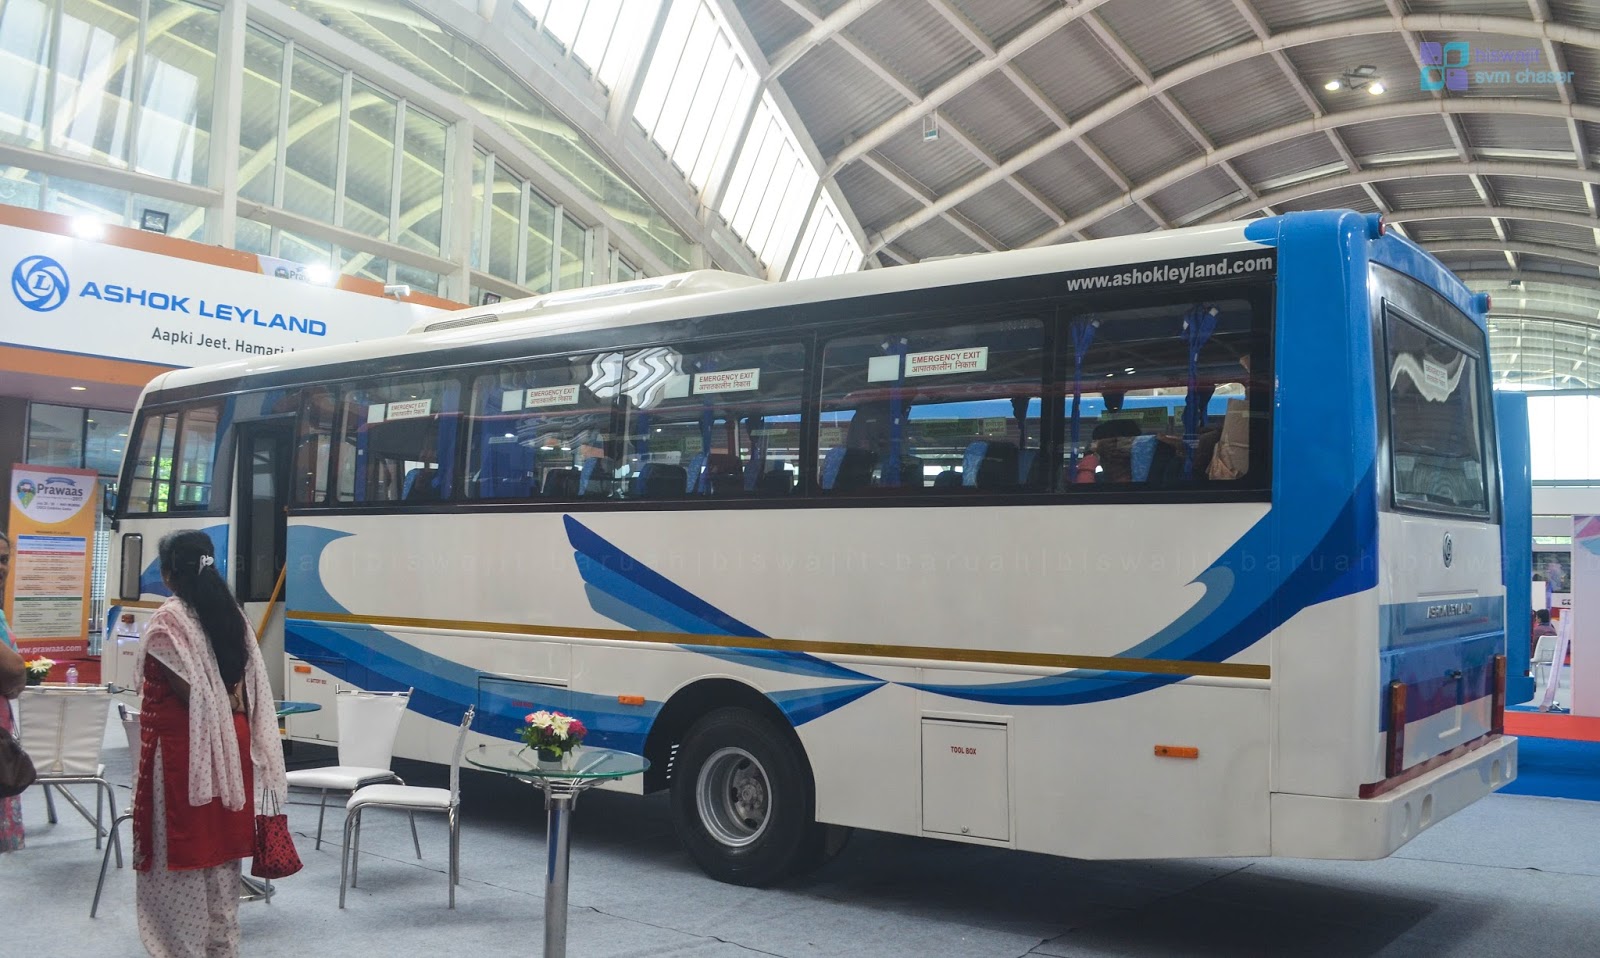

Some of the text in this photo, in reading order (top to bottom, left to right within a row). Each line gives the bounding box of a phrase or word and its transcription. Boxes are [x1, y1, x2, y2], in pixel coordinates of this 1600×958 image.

[1066, 256, 1273, 291] www.ashokleyland.com
[79, 281, 327, 337] ASHOK LEYLAND
[152, 327, 193, 345] Aapki
[196, 334, 231, 351] Jeet.
[911, 351, 981, 364] EMERGENCY EXIT
[699, 371, 754, 383] EMERGENCY EXIT
[530, 387, 576, 398] EMERGENCY EXIT
[391, 403, 417, 411] EMERGENCY
[37, 483, 84, 497] Prawaas
[17, 645, 82, 654] ww.prawaas.com
[950, 746, 977, 755] TOOL BOX
